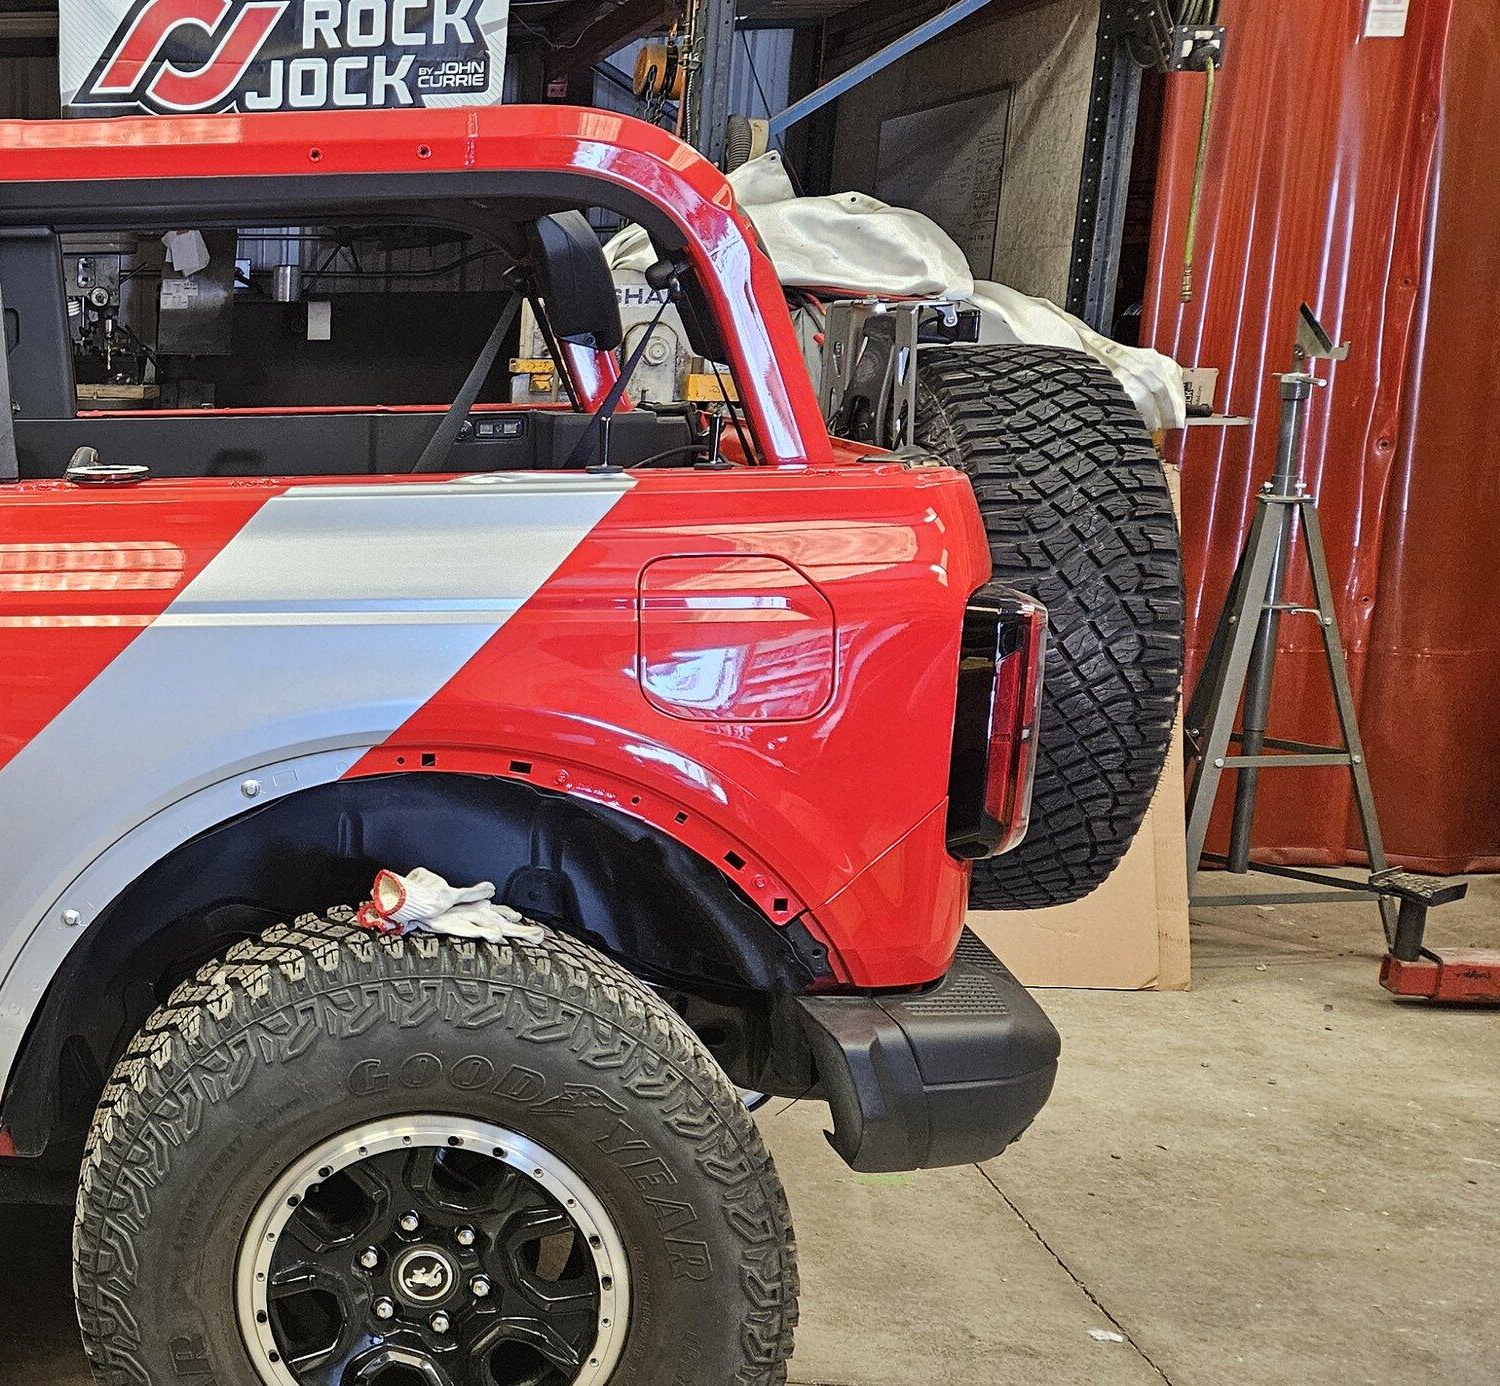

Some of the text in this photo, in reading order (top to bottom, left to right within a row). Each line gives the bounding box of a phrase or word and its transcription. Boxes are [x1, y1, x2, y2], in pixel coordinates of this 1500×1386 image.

[302, 0, 475, 49] ROCK
[245, 55, 416, 109] JOCK
[417, 73, 485, 88] CURRIE
[418, 61, 485, 75] BY JOHN
